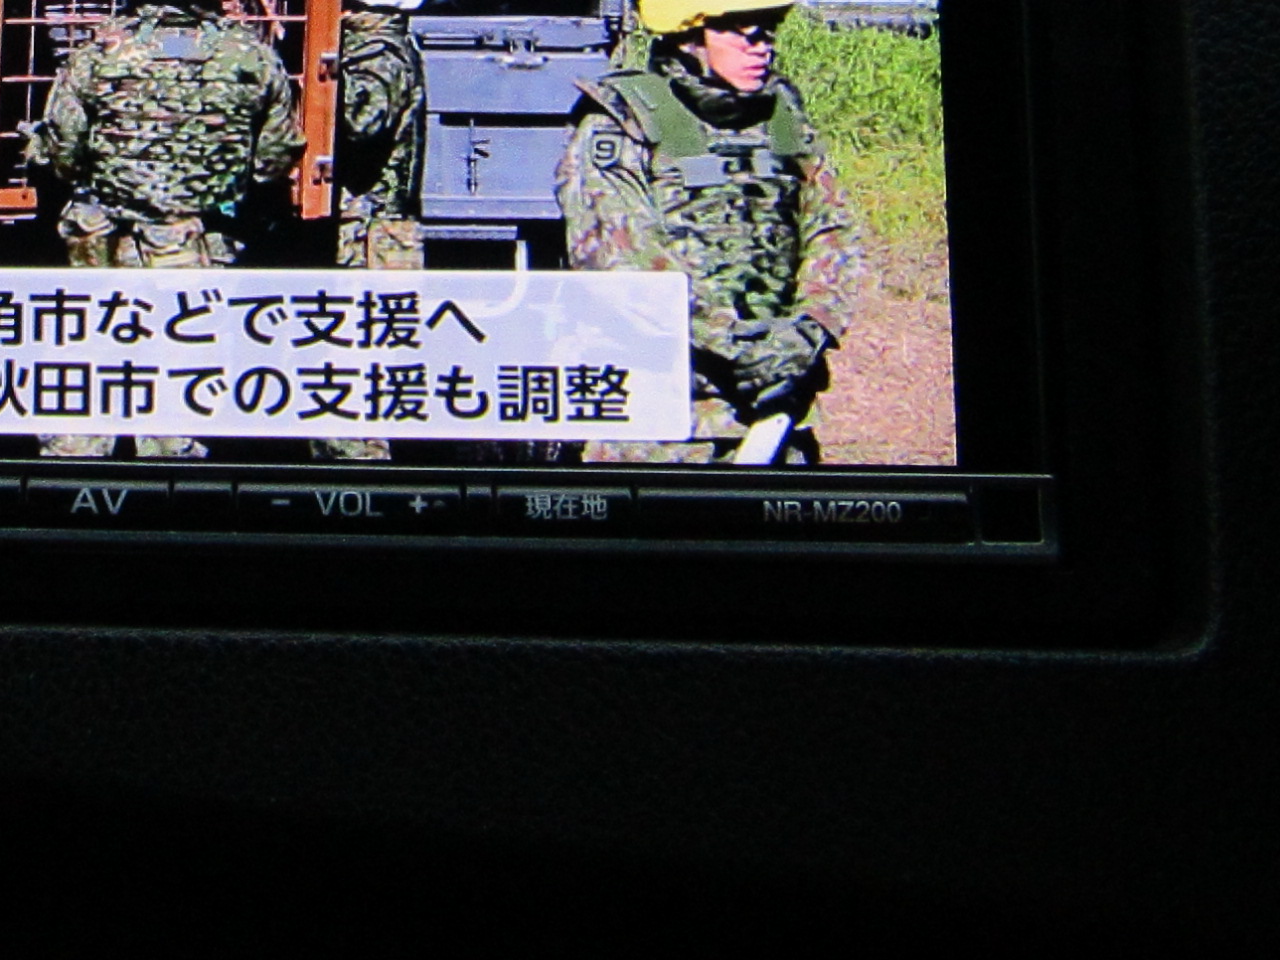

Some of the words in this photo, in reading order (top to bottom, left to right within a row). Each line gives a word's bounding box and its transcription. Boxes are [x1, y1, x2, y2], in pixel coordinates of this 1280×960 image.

[70, 486, 130, 517] AV
[315, 492, 383, 519] VOL
[524, 494, 610, 522] 現在地
[762, 499, 904, 525] NR-MZ200
